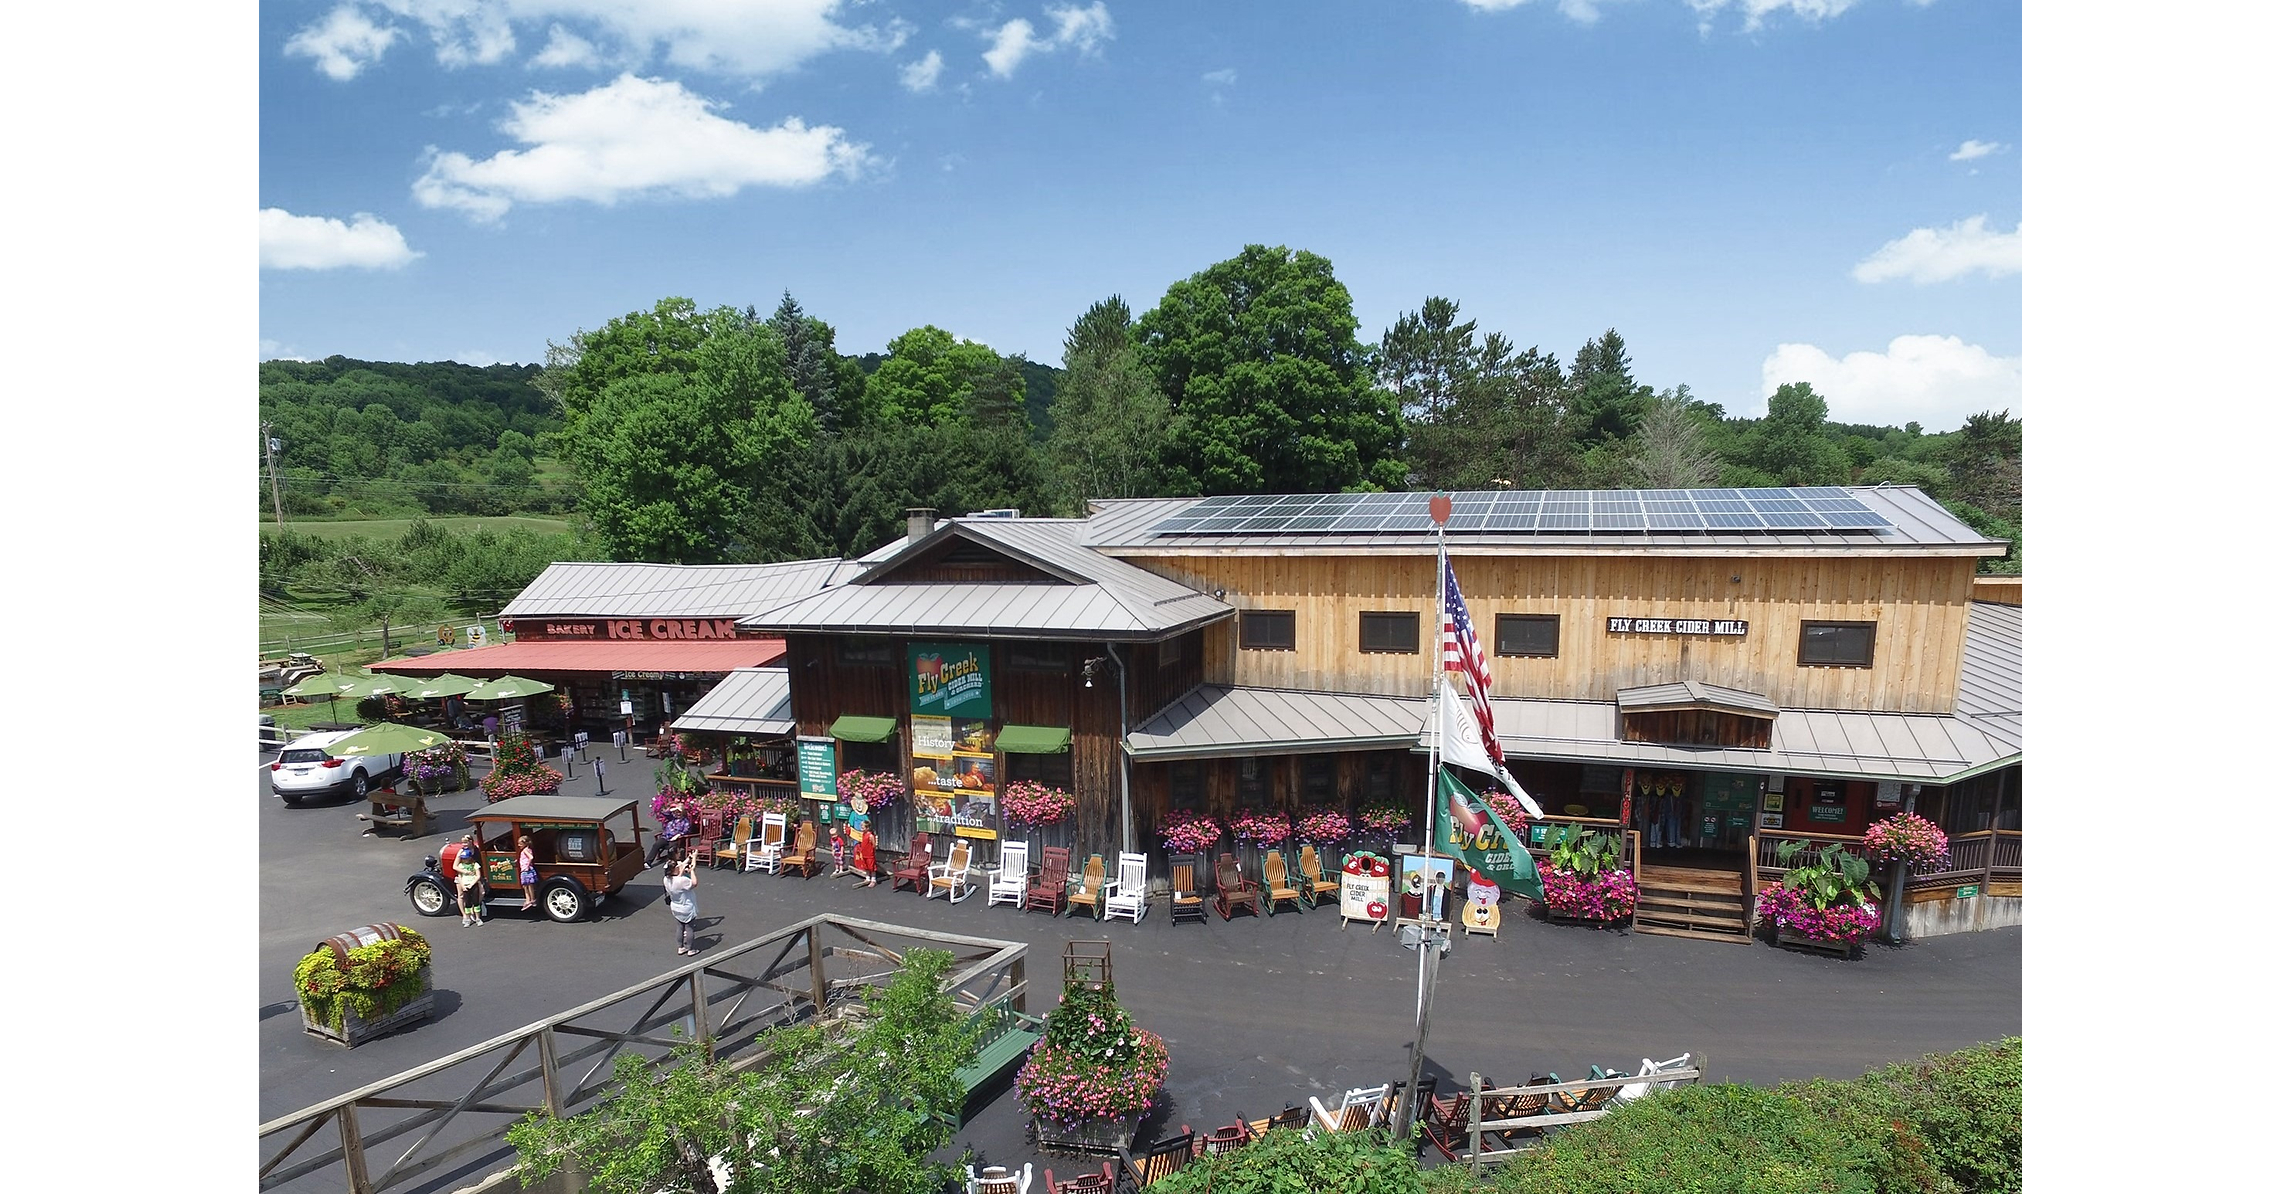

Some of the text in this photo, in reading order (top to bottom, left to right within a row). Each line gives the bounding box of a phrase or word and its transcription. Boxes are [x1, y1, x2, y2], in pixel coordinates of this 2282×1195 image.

[546, 619, 736, 639] BAKERY ICE CREAM
[1610, 619, 1745, 634] FLY CREEK CIDER MILL
[918, 652, 978, 694] Fly Creek
[948, 672, 982, 690] CIDER MILL
[918, 736, 956, 750] History
[1450, 816, 1474, 850] Fly
[1485, 852, 1514, 864] CIDE
